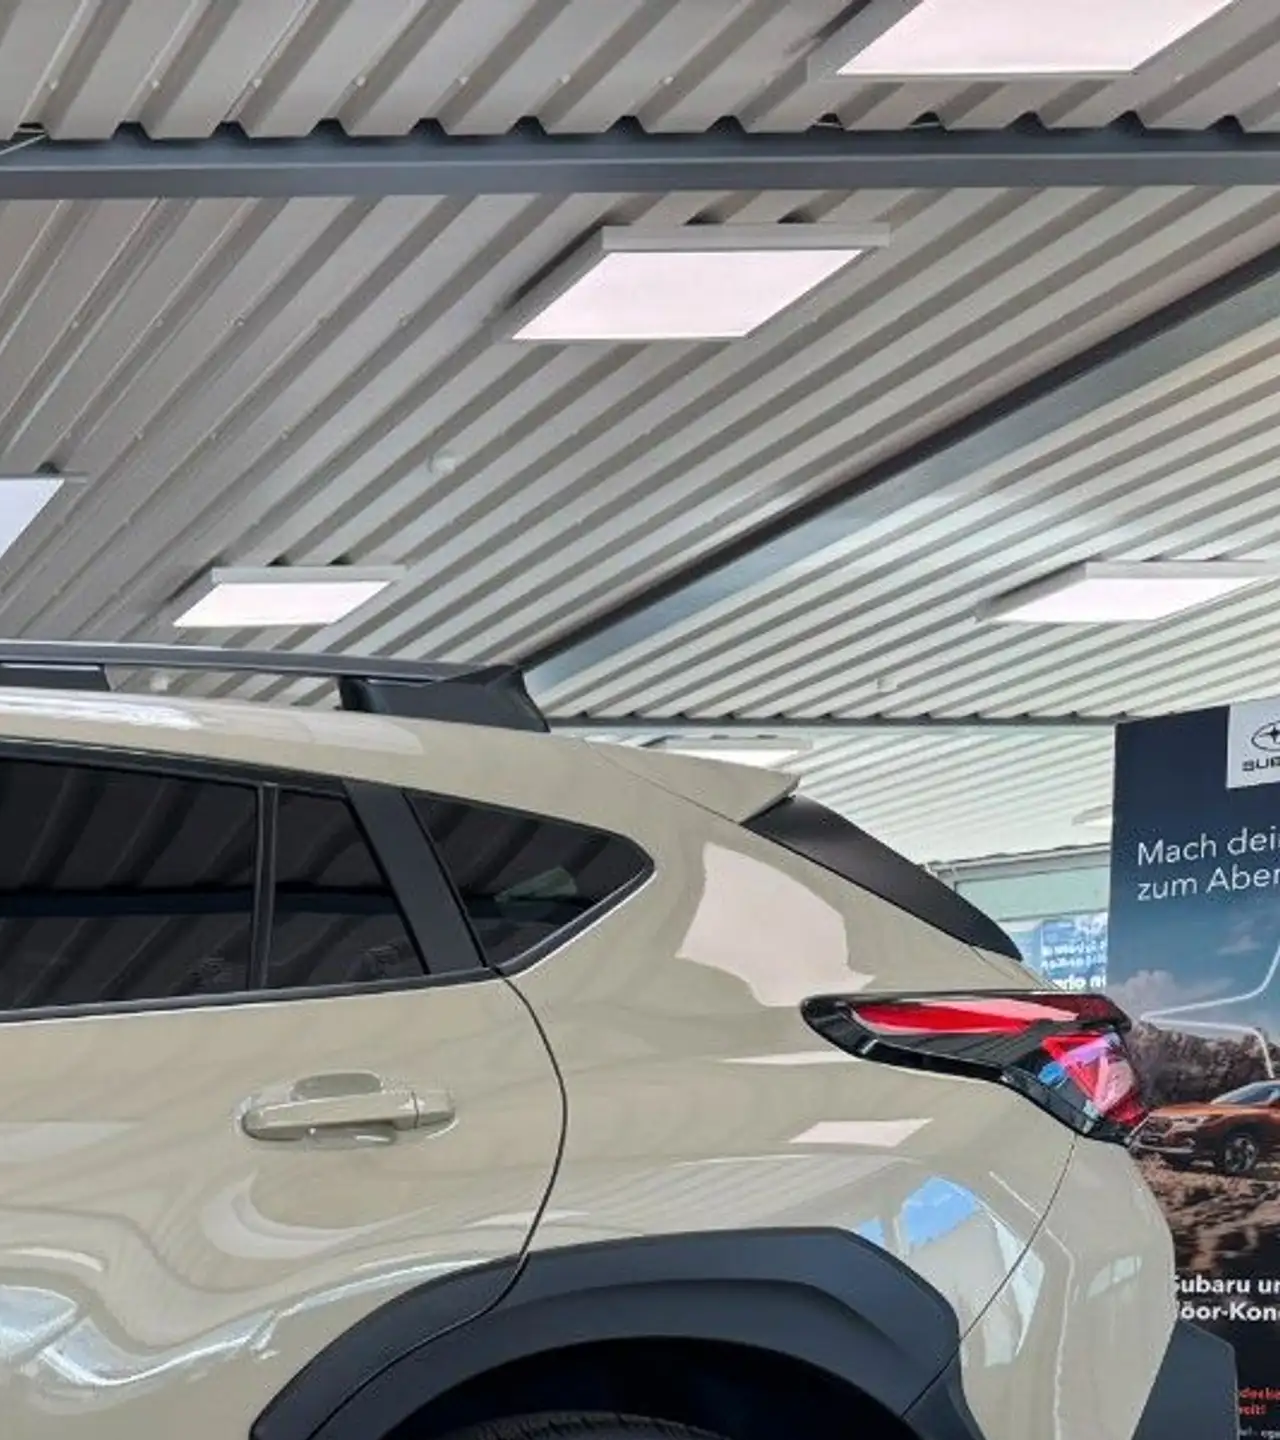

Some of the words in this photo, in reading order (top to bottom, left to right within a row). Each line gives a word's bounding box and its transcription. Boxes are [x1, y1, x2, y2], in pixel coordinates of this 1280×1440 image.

[1137, 832, 1217, 866] Mach
[1227, 826, 1280, 857] dei
[1137, 876, 1198, 902] zum
[1175, 1273, 1251, 1294] ubaru
[1179, 1301, 1280, 1321] öor-Kon
